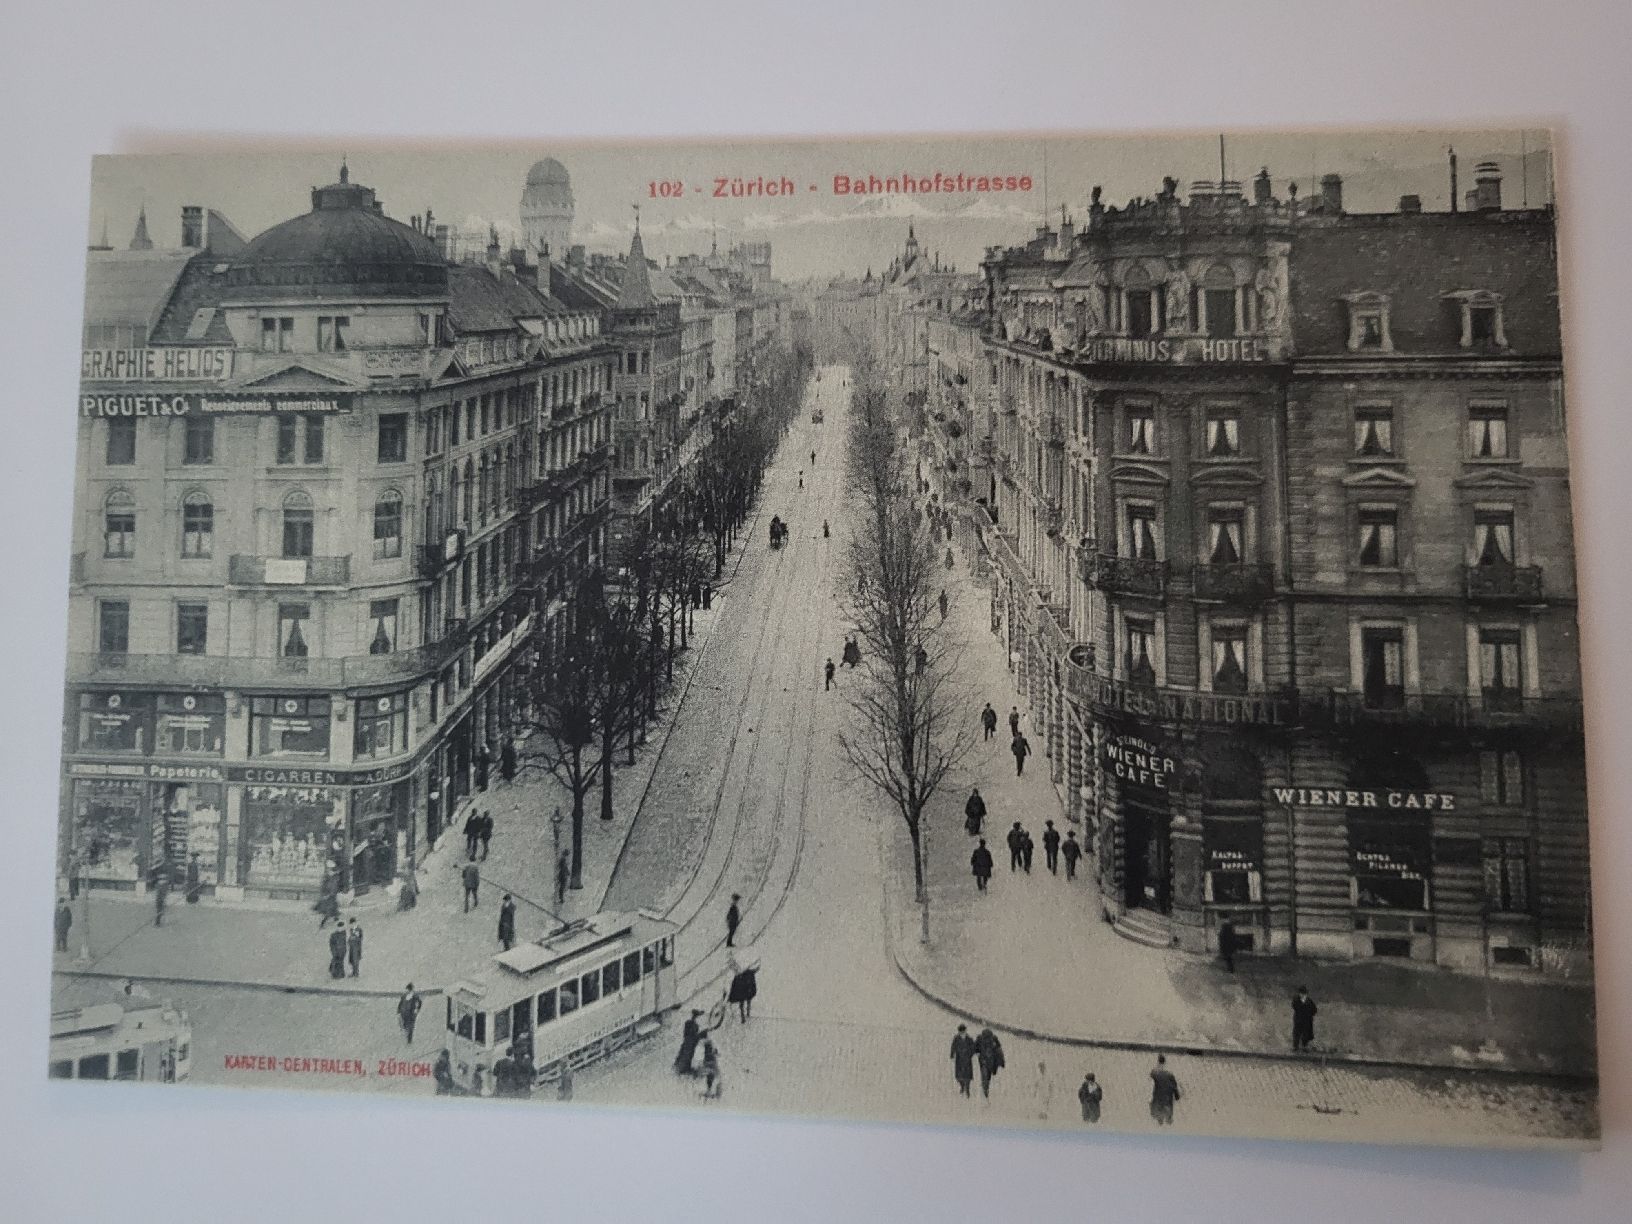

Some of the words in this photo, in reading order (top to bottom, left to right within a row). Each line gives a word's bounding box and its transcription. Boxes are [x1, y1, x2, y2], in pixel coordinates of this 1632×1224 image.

[648, 181, 684, 198] 102
[712, 175, 795, 197] Zürich
[832, 173, 1034, 196] Bahnhofstrasse
[1202, 340, 1263, 362] HOTEL
[82, 350, 155, 379] GRAPHIE
[165, 350, 225, 378] HELIOS
[1106, 743, 1176, 774] WIENER
[245, 770, 337, 783] CIGARREN
[1115, 762, 1166, 788] CAFE
[1273, 788, 1378, 807] WIENER
[1388, 793, 1456, 810] CAFE
[378, 1059, 432, 1077] ZÜRICH
